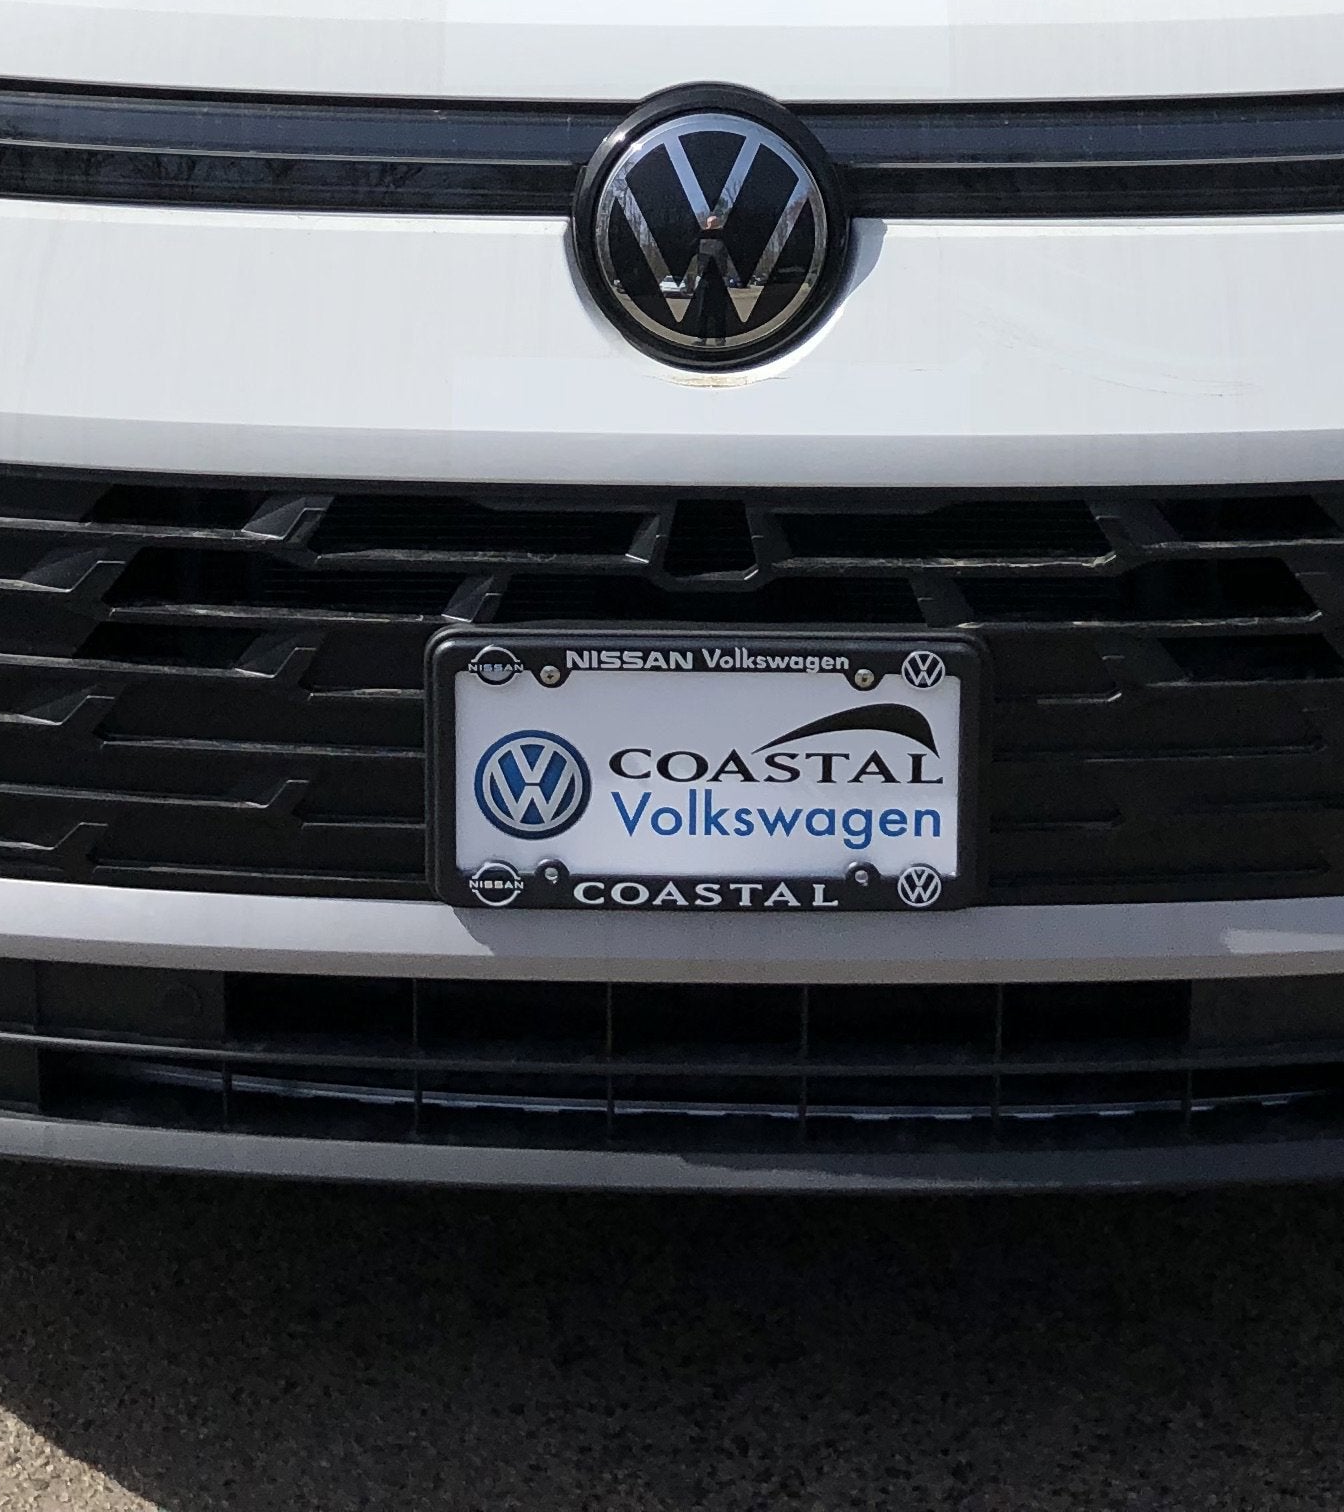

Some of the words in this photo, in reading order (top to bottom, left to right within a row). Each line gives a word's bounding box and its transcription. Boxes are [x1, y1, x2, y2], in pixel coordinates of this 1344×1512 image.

[566, 649, 693, 670] NISSAN
[701, 647, 850, 672] Volkswagen
[609, 748, 944, 784] COASTAL
[610, 788, 942, 850] Volkswagen
[573, 880, 839, 907] COASTAL
